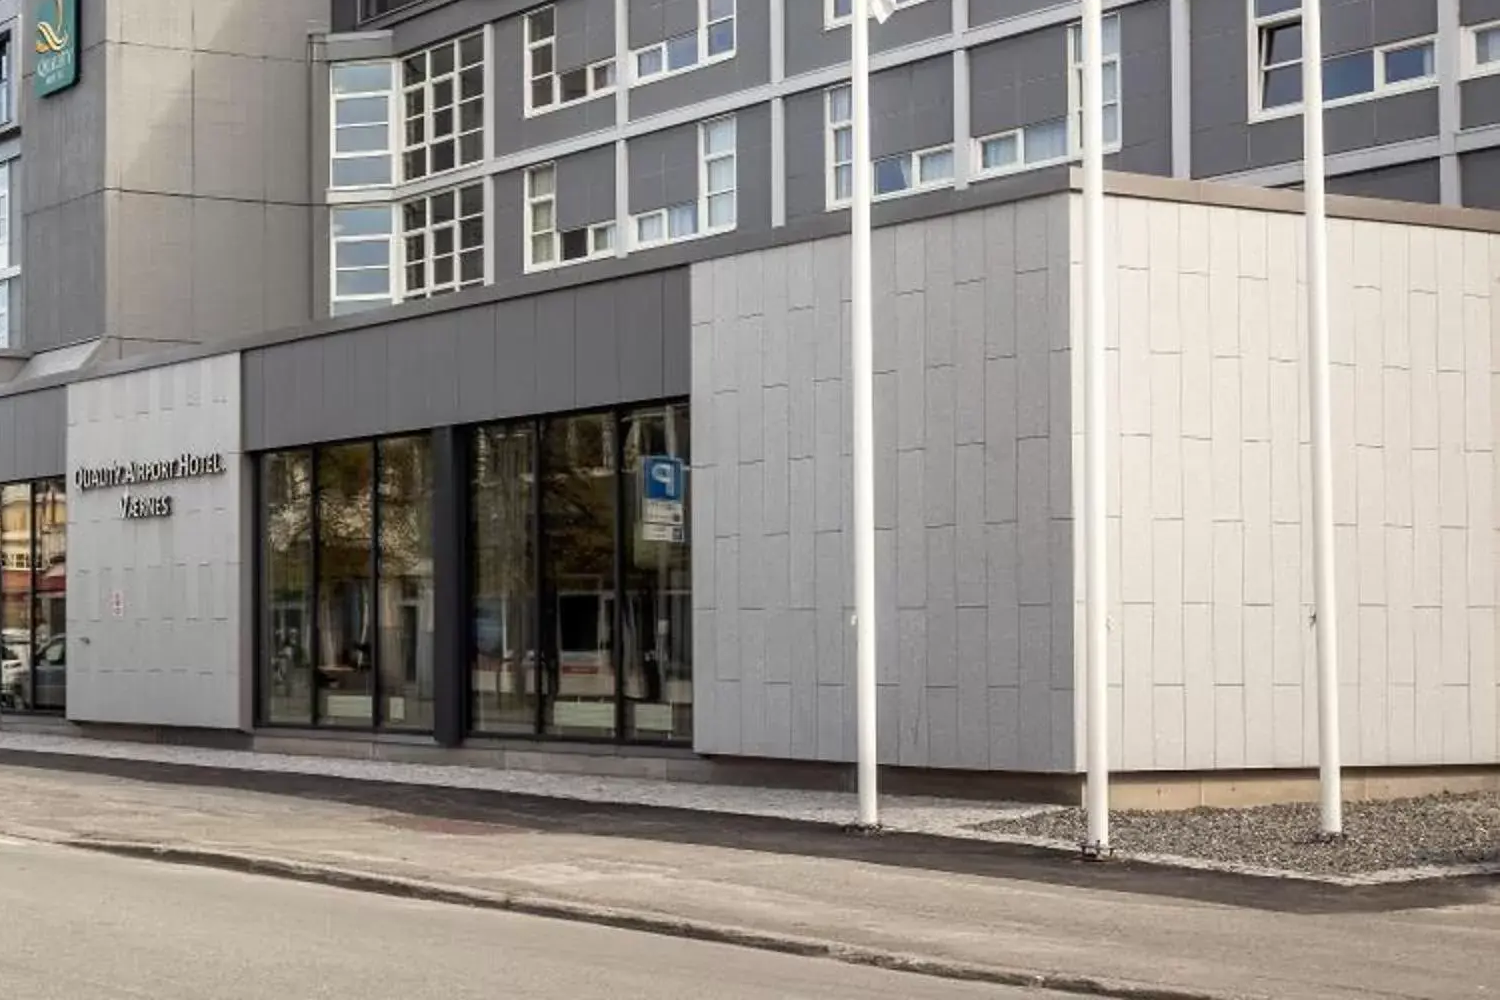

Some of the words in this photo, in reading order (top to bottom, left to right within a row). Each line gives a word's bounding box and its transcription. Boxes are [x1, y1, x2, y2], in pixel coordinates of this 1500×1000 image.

[74, 466, 124, 491] QUALITY
[125, 460, 177, 483] AIRPORT
[179, 453, 222, 478] HOTEL
[119, 496, 172, 519] VÆRNES
